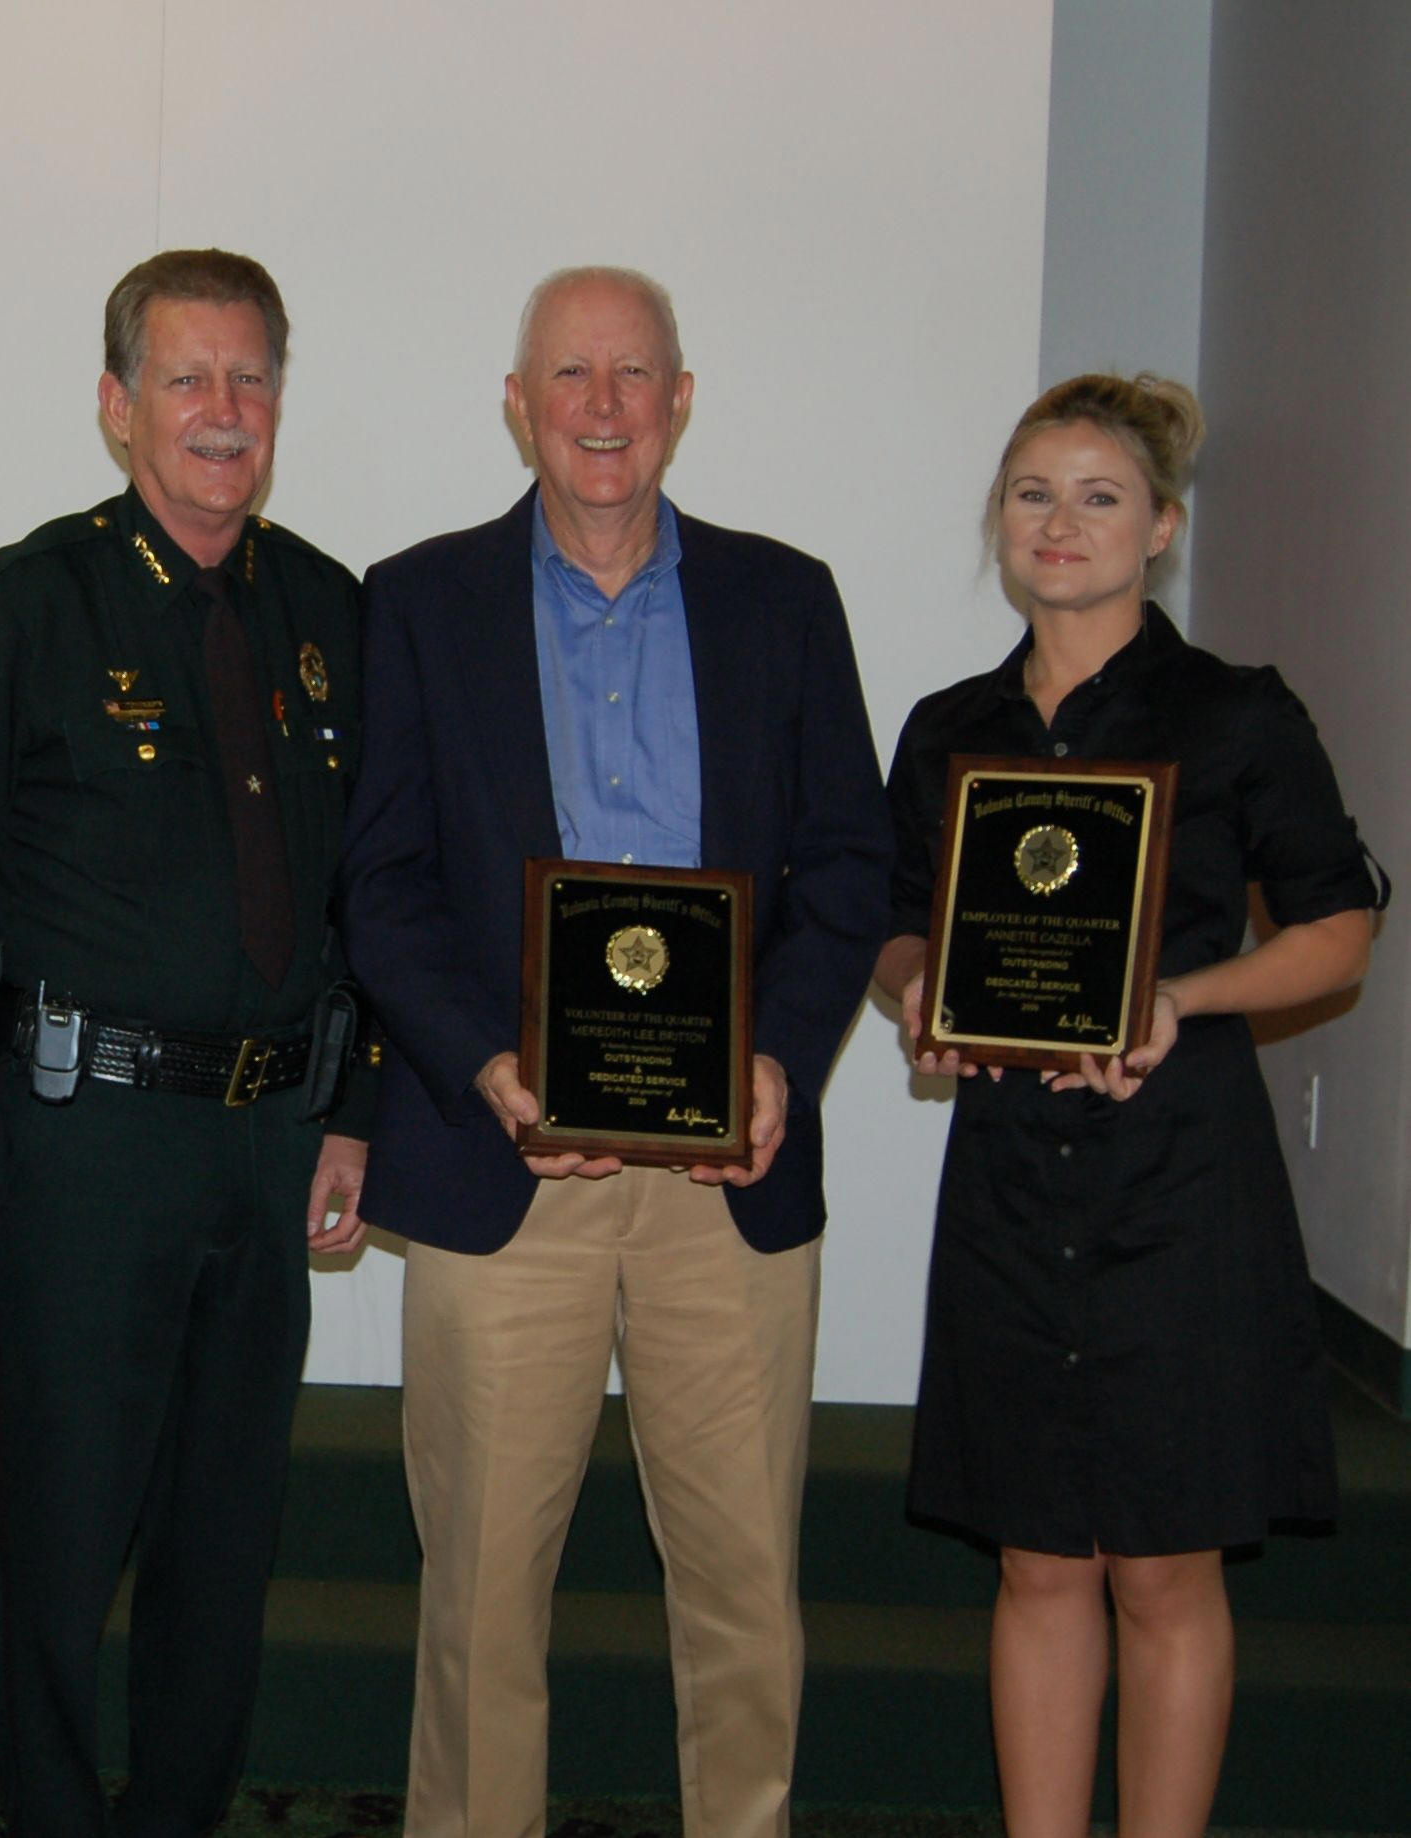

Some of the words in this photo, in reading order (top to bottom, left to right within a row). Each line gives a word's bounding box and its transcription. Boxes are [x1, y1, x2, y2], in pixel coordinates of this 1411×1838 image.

[962, 912, 1021, 923] EMPLOYEE
[1024, 914, 1039, 924] OF
[1042, 916, 1064, 926] THE
[1066, 917, 1120, 930] QUARTER
[985, 930, 1036, 943] ANNETTE
[1040, 933, 1092, 945] CAZELLA
[1002, 958, 1069, 970] OUTSTANDING
[985, 978, 1038, 988] DEDICATED
[1041, 981, 1081, 992] SERVICE
[565, 1008, 626, 1021] VOLUNTEER
[628, 1011, 640, 1022] OF
[644, 1013, 663, 1024] THE
[665, 1014, 712, 1026] QUARTER
[571, 1025, 631, 1038] MEREDITH
[634, 1029, 655, 1040] LEE
[604, 1053, 672, 1065] OUTSTANDING
[589, 1073, 642, 1083] DEDICATED
[646, 1076, 687, 1087] SERVICE
